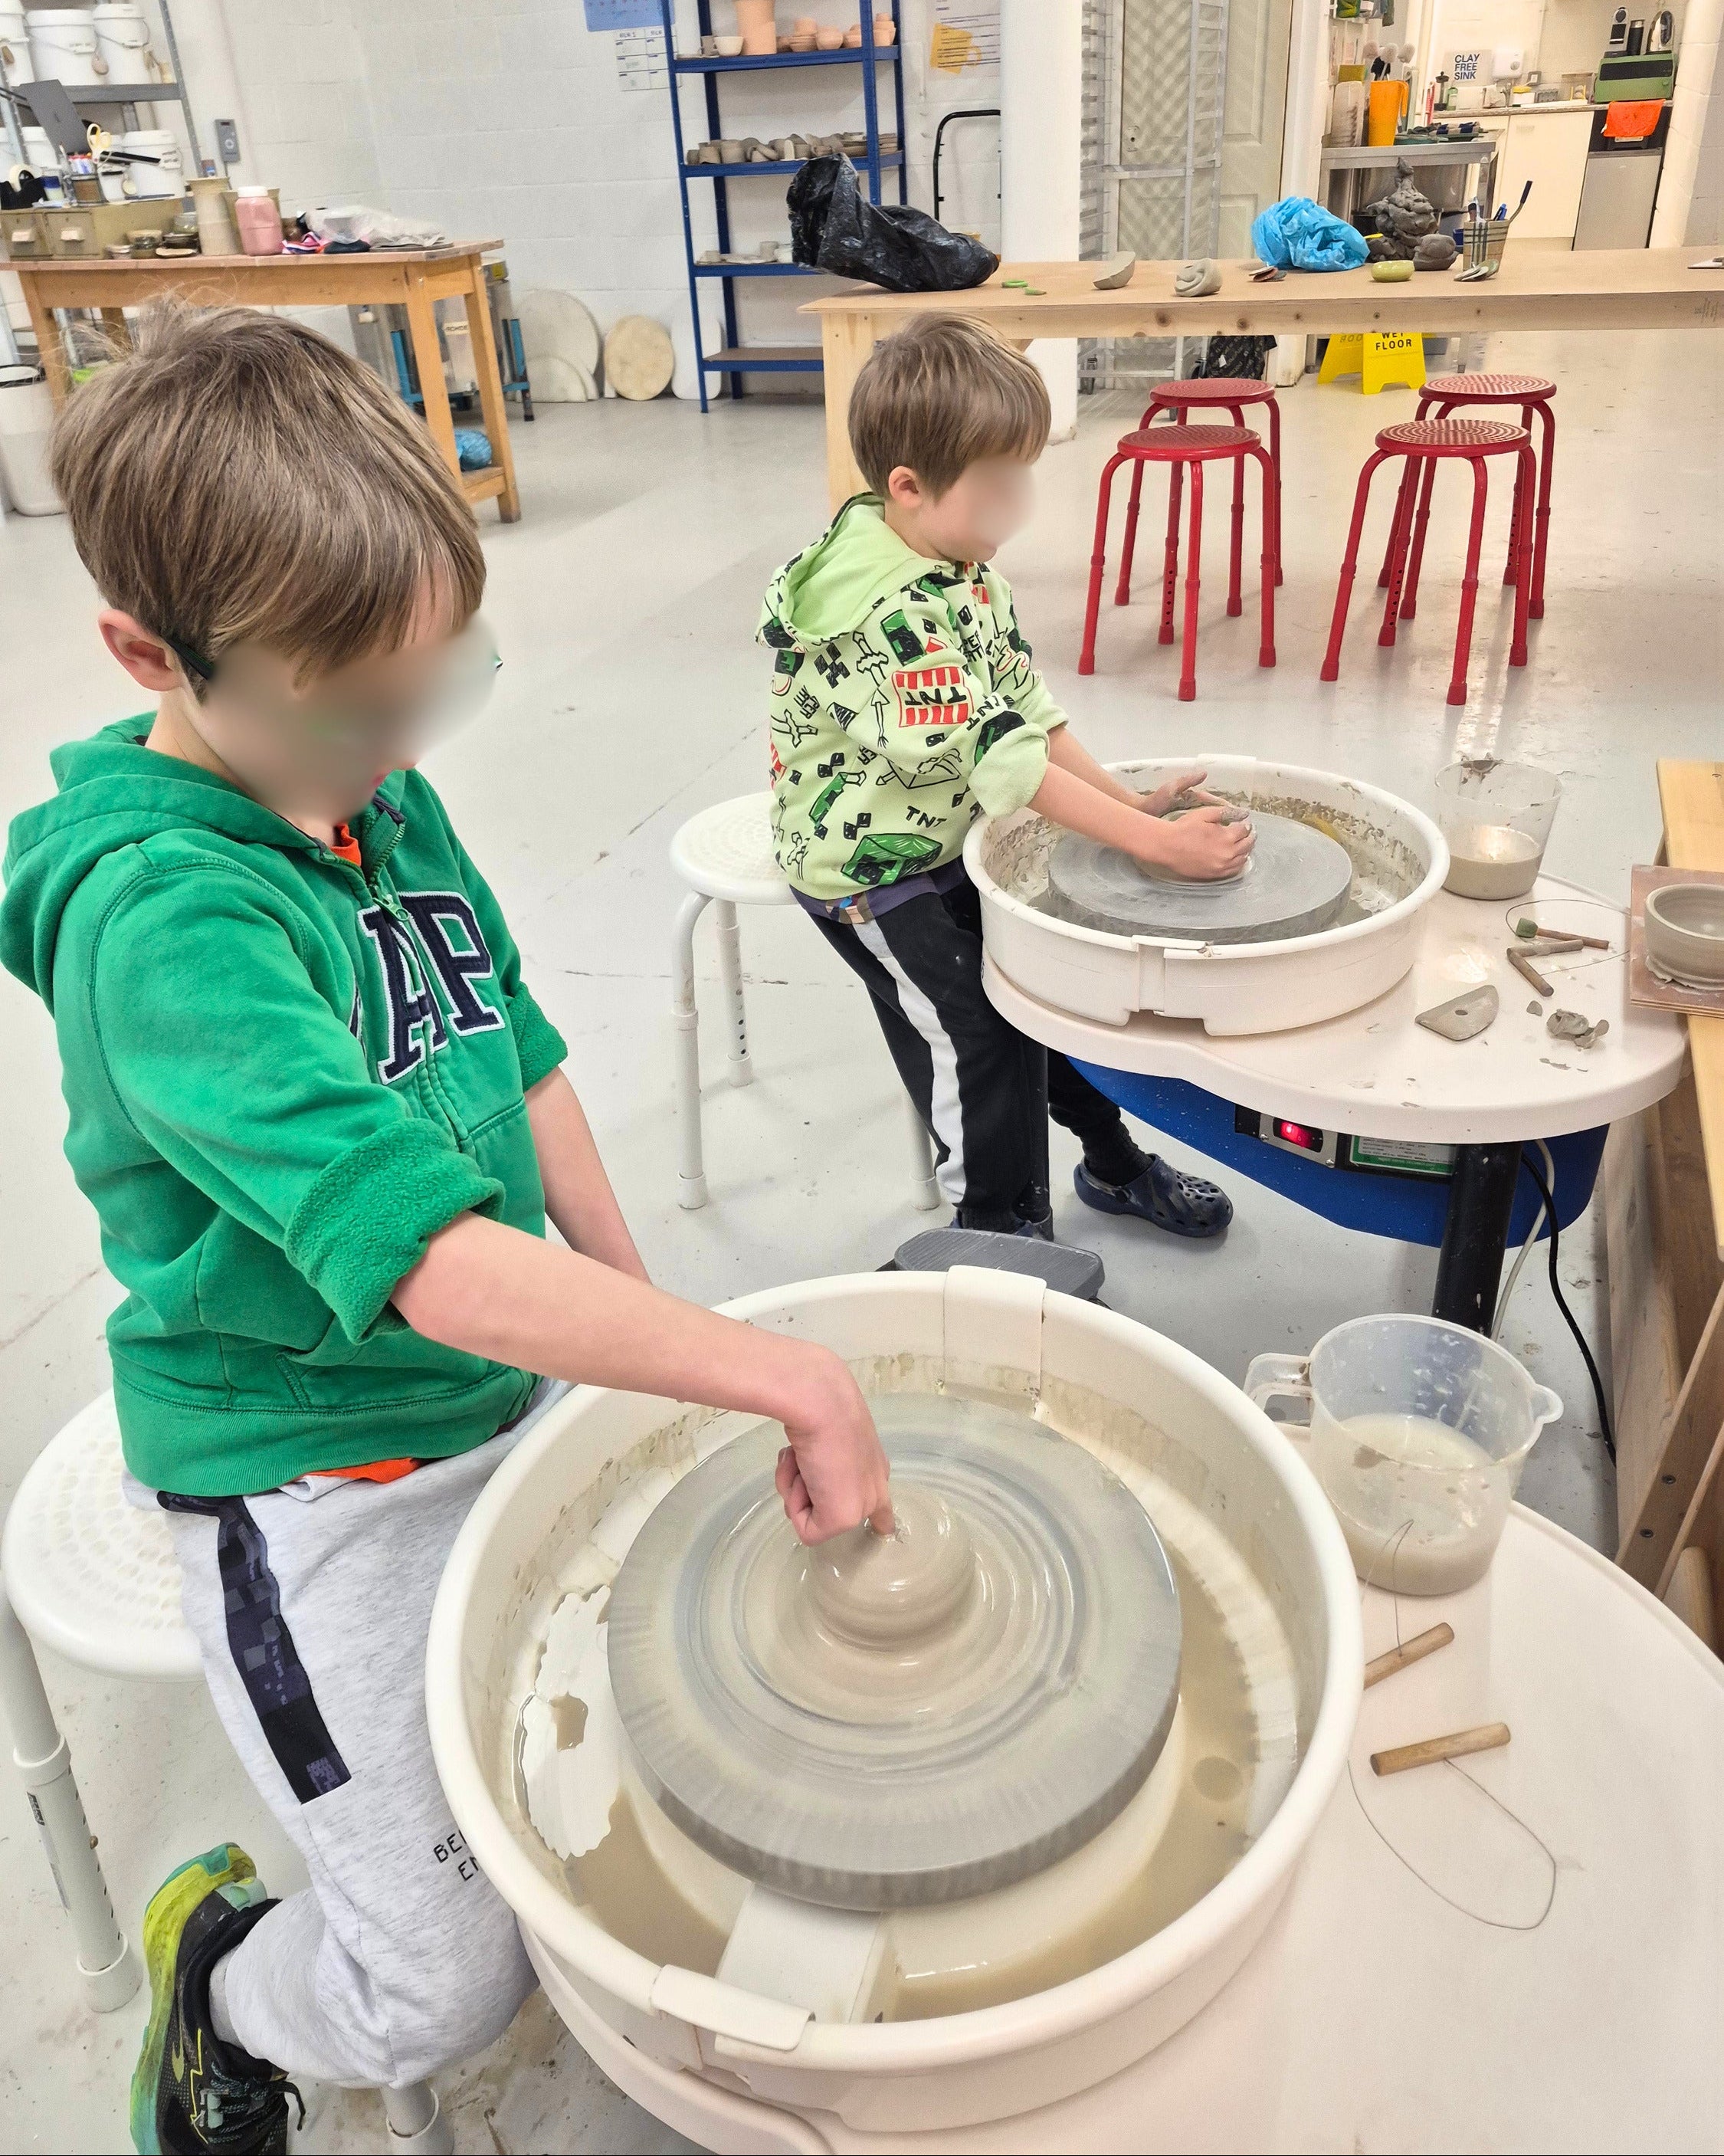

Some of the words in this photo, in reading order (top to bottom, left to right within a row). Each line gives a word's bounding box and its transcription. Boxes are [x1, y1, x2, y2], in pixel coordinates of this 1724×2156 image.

[1454, 54, 1480, 64] CLAY
[1454, 62, 1478, 71] FREE
[1454, 71, 1477, 80] SINK
[1375, 339, 1412, 350] FLOOR
[905, 686, 967, 705] TNT
[906, 806, 947, 828] TNT
[349, 891, 505, 1085] AP
